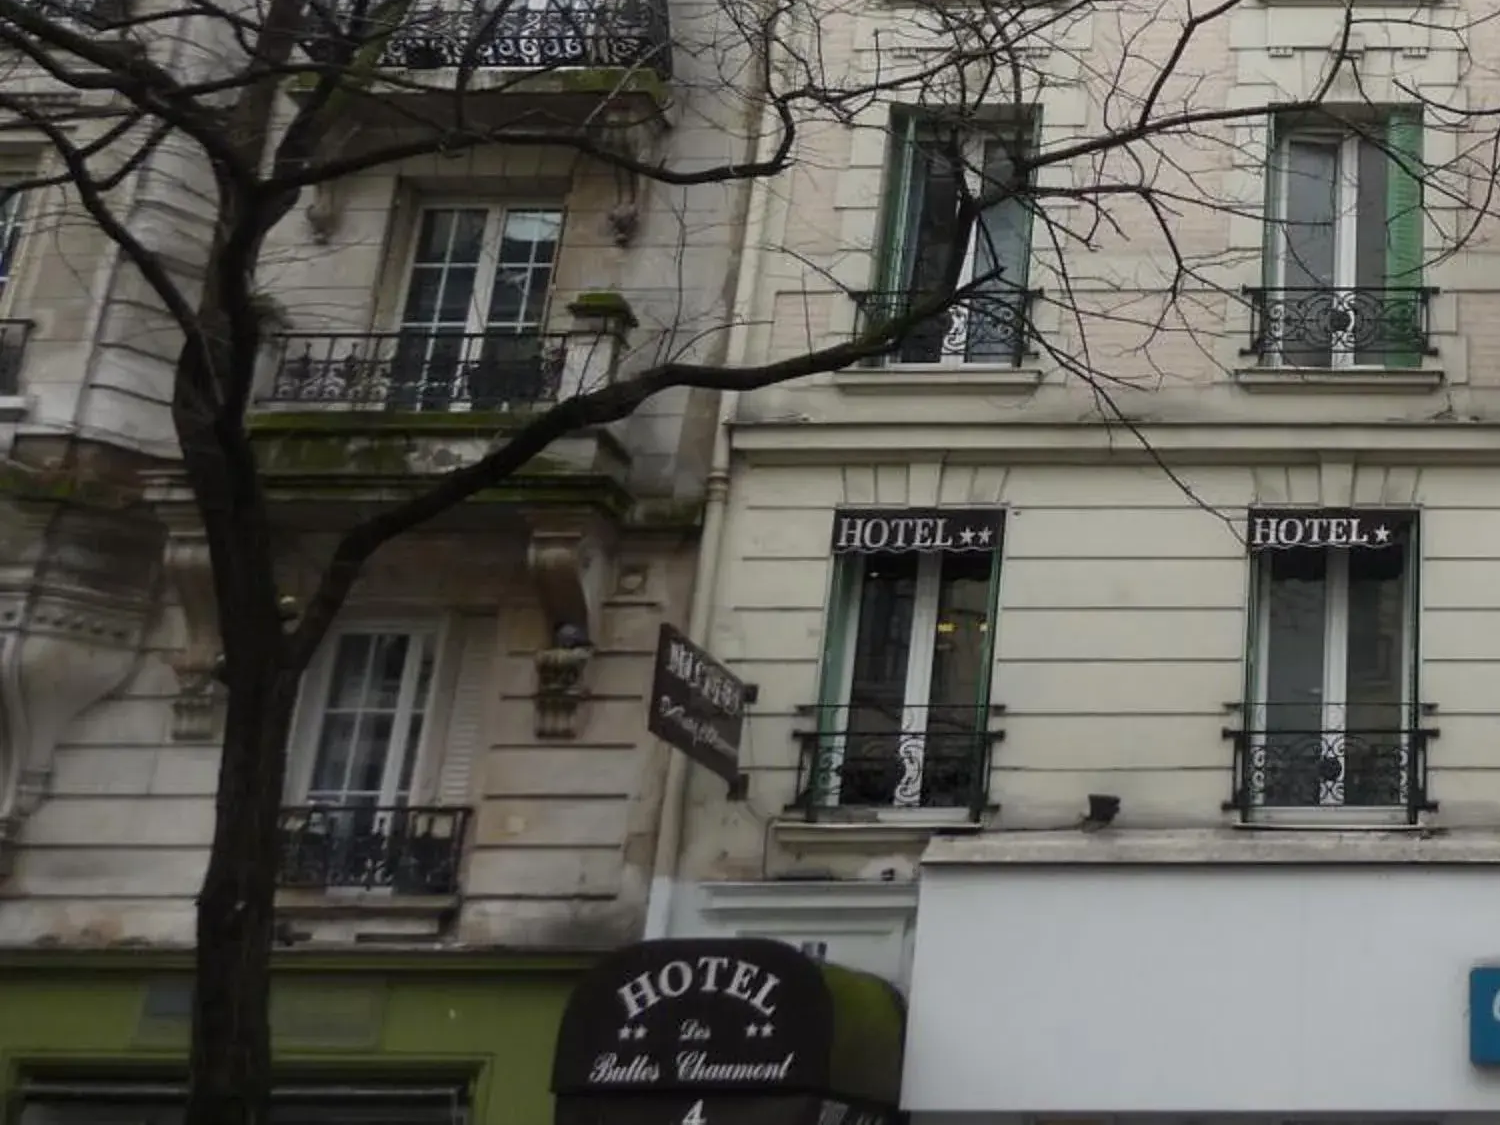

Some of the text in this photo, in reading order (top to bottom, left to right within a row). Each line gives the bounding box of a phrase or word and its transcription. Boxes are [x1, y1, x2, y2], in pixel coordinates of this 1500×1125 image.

[836, 518, 953, 547] HOTEL
[1252, 518, 1369, 544] HOTEL
[617, 955, 781, 1018] HOTEL
